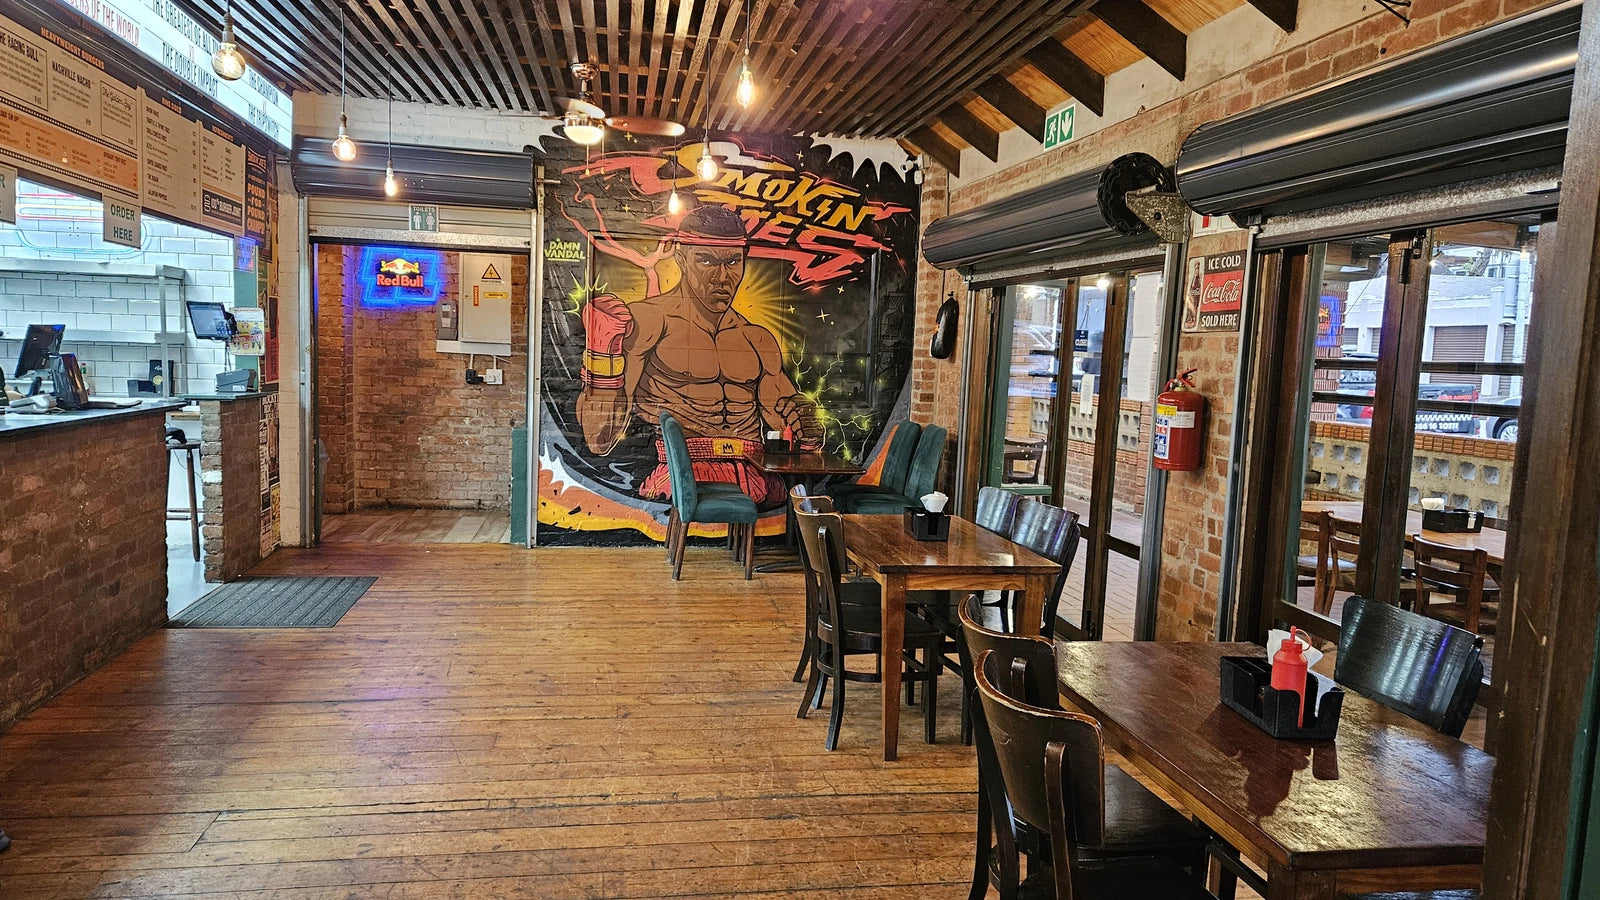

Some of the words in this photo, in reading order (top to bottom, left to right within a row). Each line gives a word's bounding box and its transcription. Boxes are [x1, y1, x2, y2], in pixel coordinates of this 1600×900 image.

[102, 4, 115, 31] THE
[116, 13, 140, 46] WORLD
[165, 0, 193, 42] GREATEST
[41, 27, 81, 57] HEAVYWEIGHT
[26, 44, 39, 62] BULL
[52, 61, 76, 82] NASHVILLE
[162, 42, 173, 70] THE
[175, 51, 197, 85] DOUBLE
[197, 67, 218, 98] IMPACT
[110, 204, 135, 221] ORDER
[113, 226, 133, 242] HERE
[549, 240, 581, 251] DAMN
[544, 249, 586, 260] VANDAL
[1208, 258, 1220, 271] ICE
[1221, 255, 1241, 269] COLD
[376, 273, 400, 286] Red
[400, 275, 424, 288] Bull
[1201, 315, 1219, 328] SOLD
[1219, 313, 1238, 327] HERE
